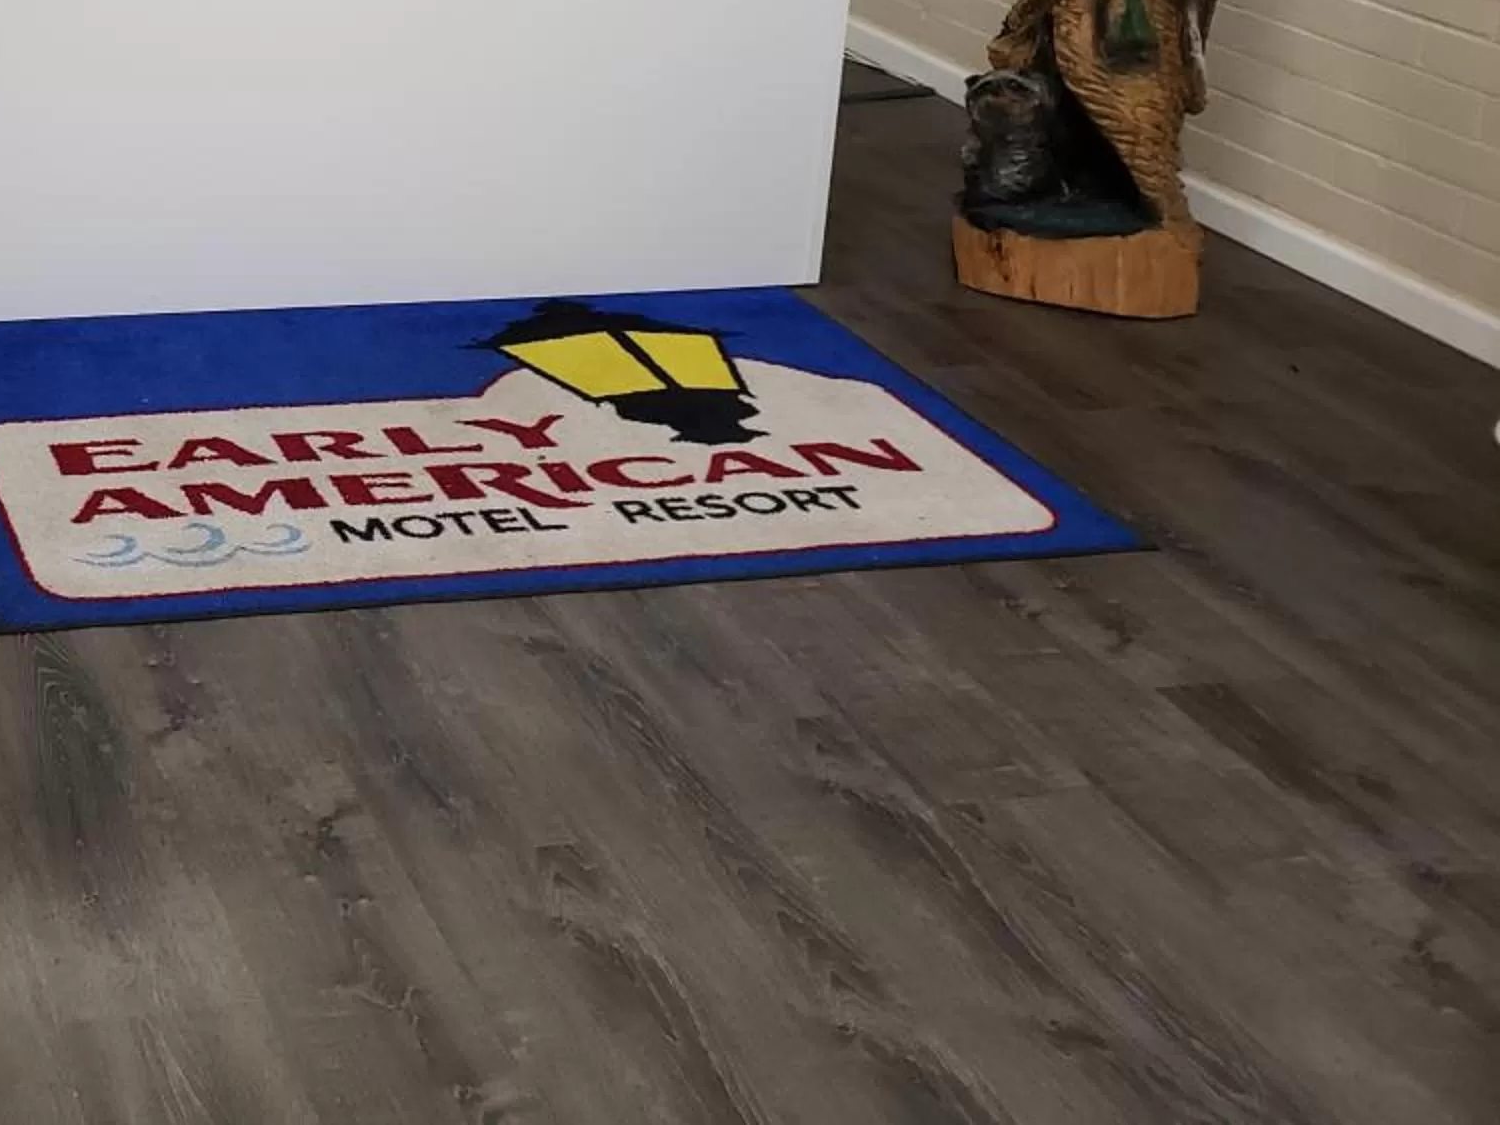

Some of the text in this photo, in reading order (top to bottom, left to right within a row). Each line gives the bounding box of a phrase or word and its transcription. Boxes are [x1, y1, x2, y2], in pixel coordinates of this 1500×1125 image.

[48, 415, 564, 475] EARLY
[70, 439, 923, 522] AMERICAN
[329, 486, 862, 544] MOTEL RESORT
